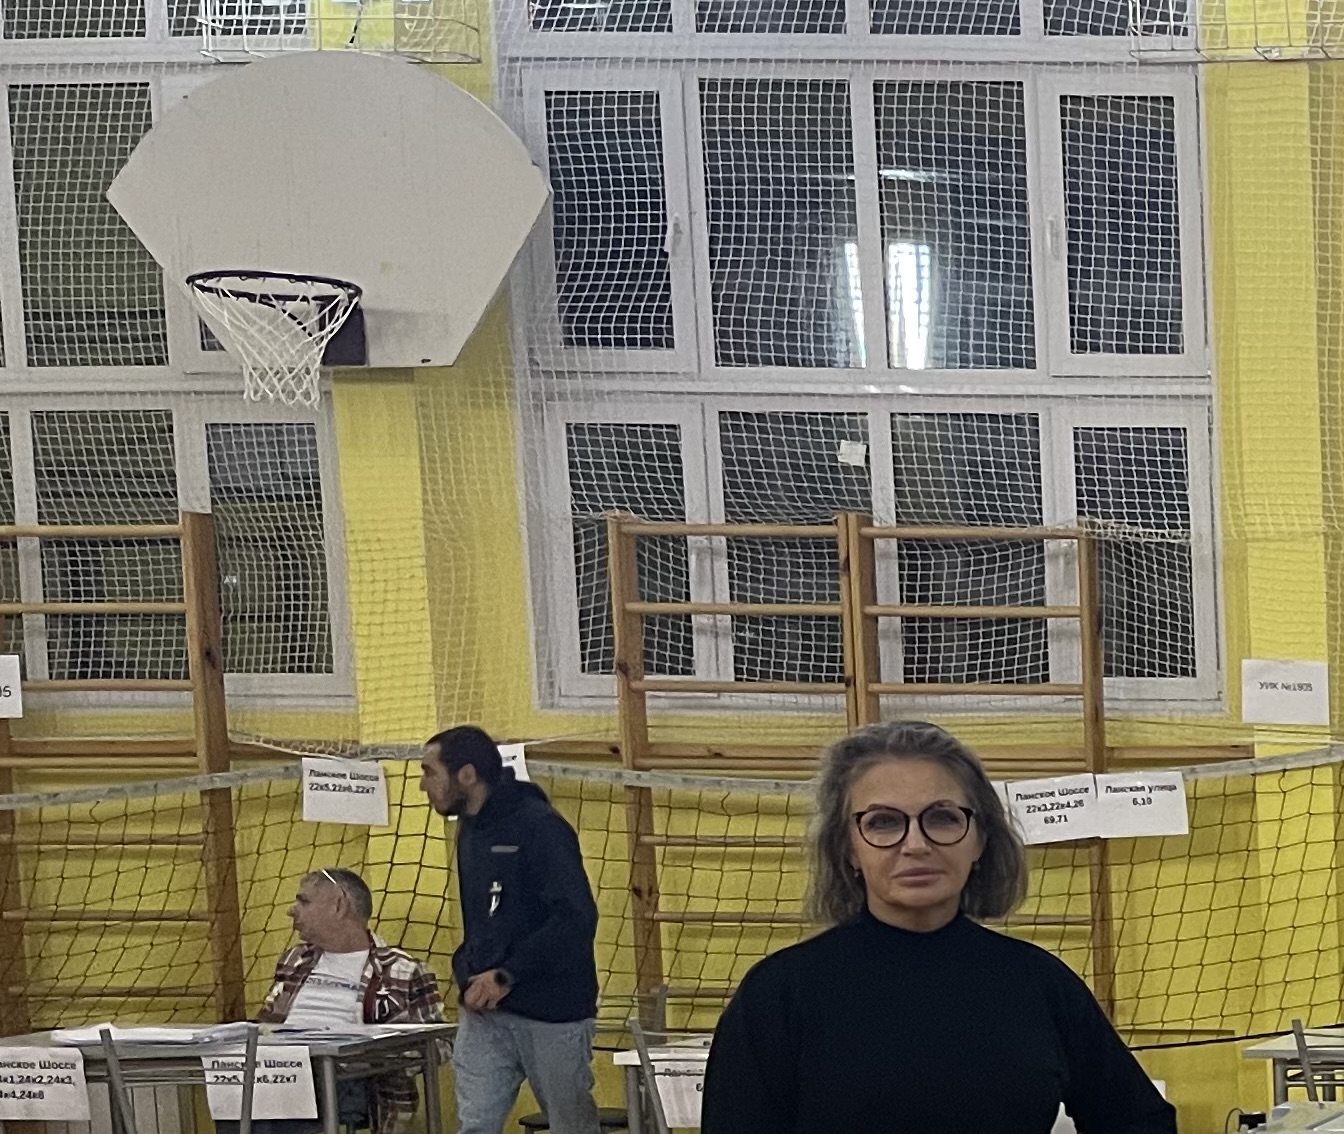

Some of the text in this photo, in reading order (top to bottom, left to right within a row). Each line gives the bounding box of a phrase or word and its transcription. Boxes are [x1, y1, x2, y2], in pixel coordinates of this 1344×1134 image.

[1259, 681, 1279, 690] УИК
[1015, 787, 1090, 802] Ланское Шоссе
[0, 1060, 77, 1070] анское Шоссе
[264, 1060, 303, 1069] Шоссе
